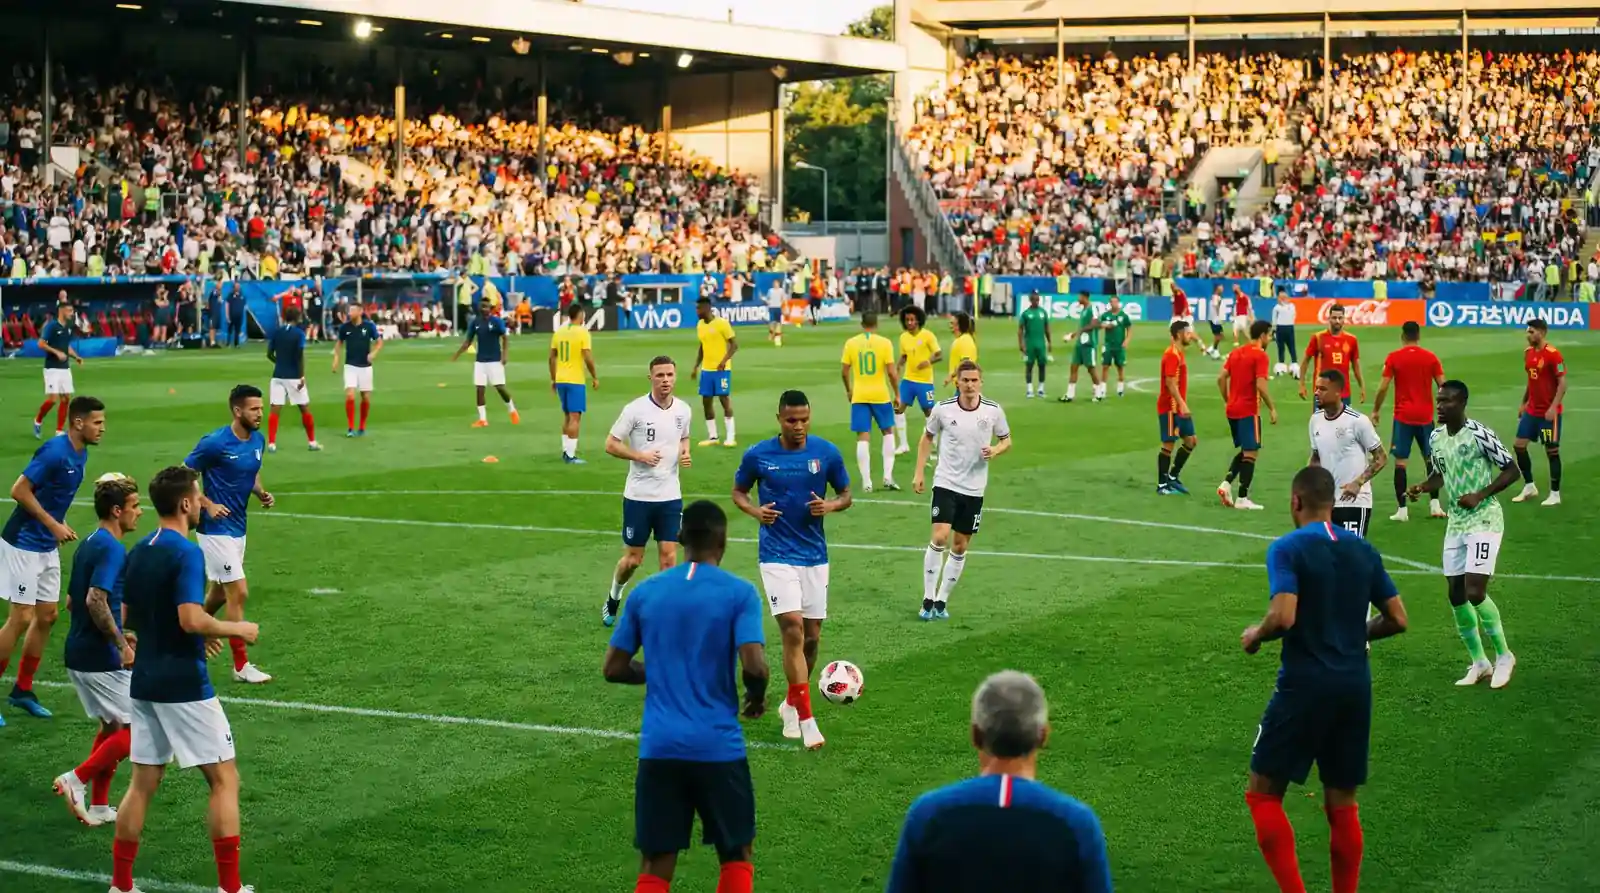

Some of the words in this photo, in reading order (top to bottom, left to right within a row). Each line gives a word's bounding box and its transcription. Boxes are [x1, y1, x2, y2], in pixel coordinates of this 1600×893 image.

[1457, 304, 1502, 325] 万达
[1503, 306, 1585, 326] WANDA
[560, 340, 569, 362] 11
[858, 351, 877, 375] 10
[646, 428, 656, 442] 9
[1343, 520, 1359, 537] 15
[1475, 542, 1490, 560] 19
